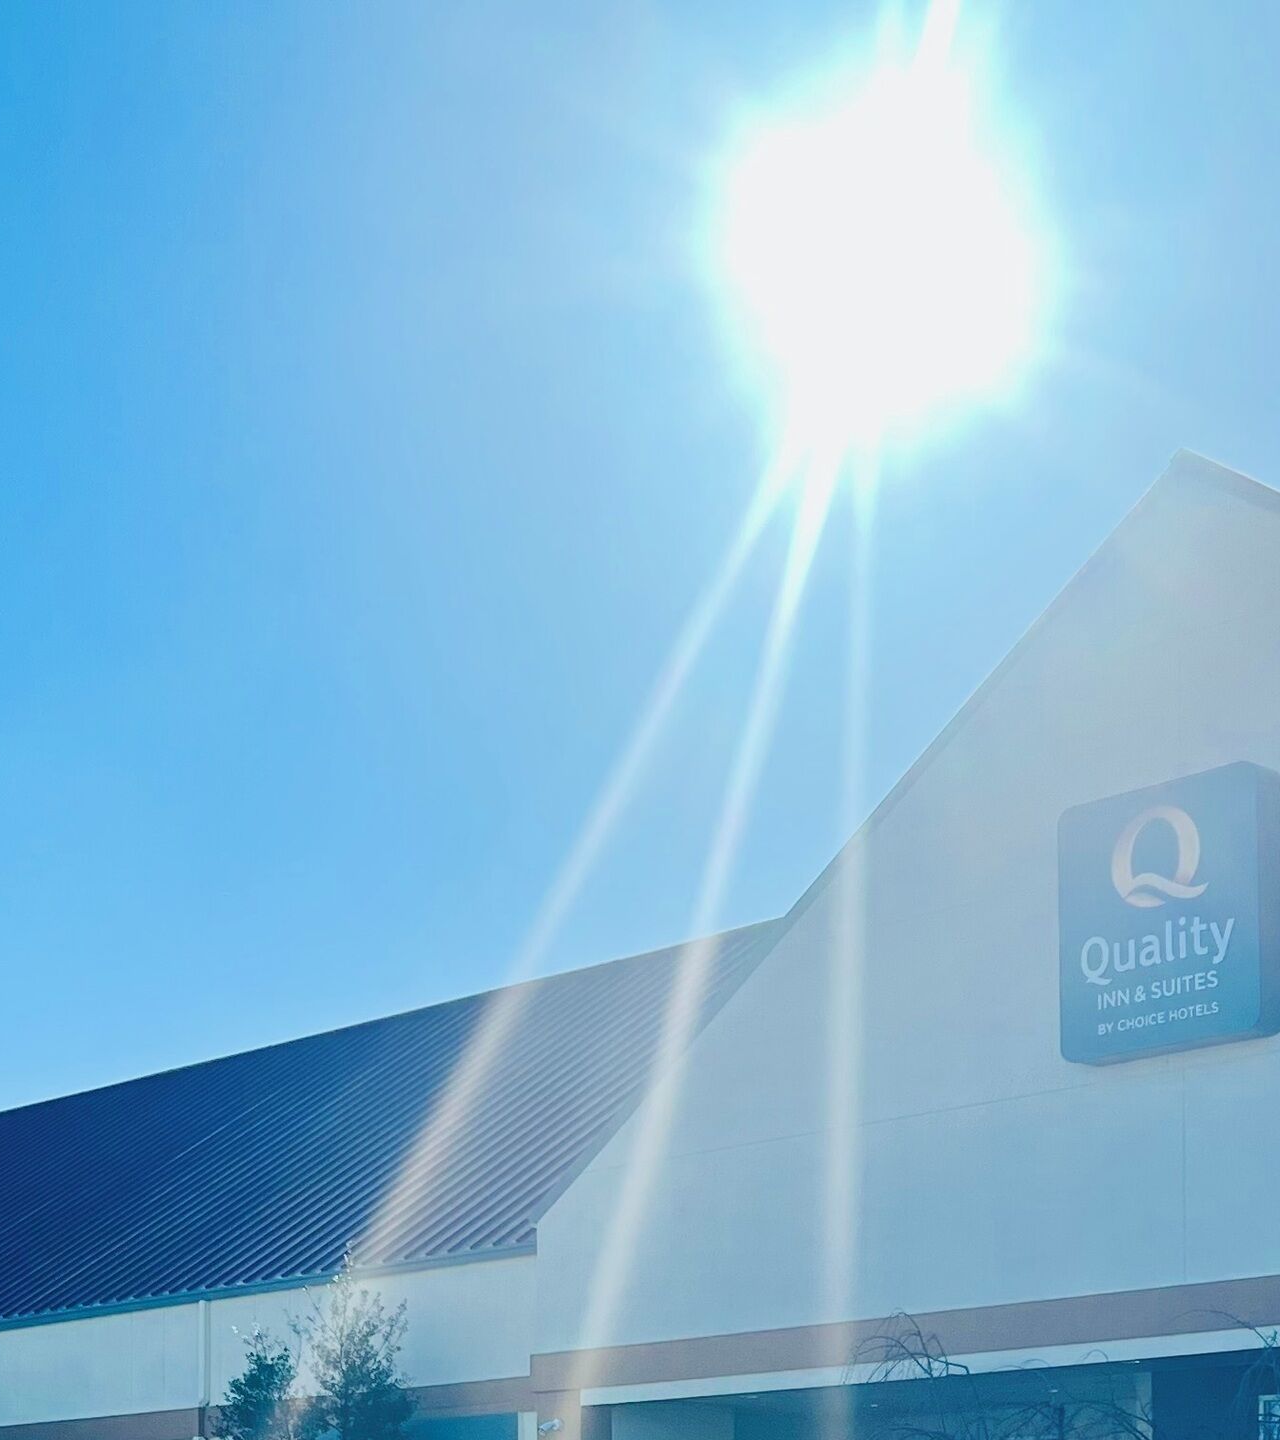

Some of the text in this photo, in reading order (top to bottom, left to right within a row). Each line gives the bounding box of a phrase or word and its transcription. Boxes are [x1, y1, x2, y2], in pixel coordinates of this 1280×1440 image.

[1081, 916, 1235, 986] Quality
[1097, 970, 1218, 1010] INN & SUITES
[1098, 1001, 1219, 1036] BY CHOICE HOTELS
